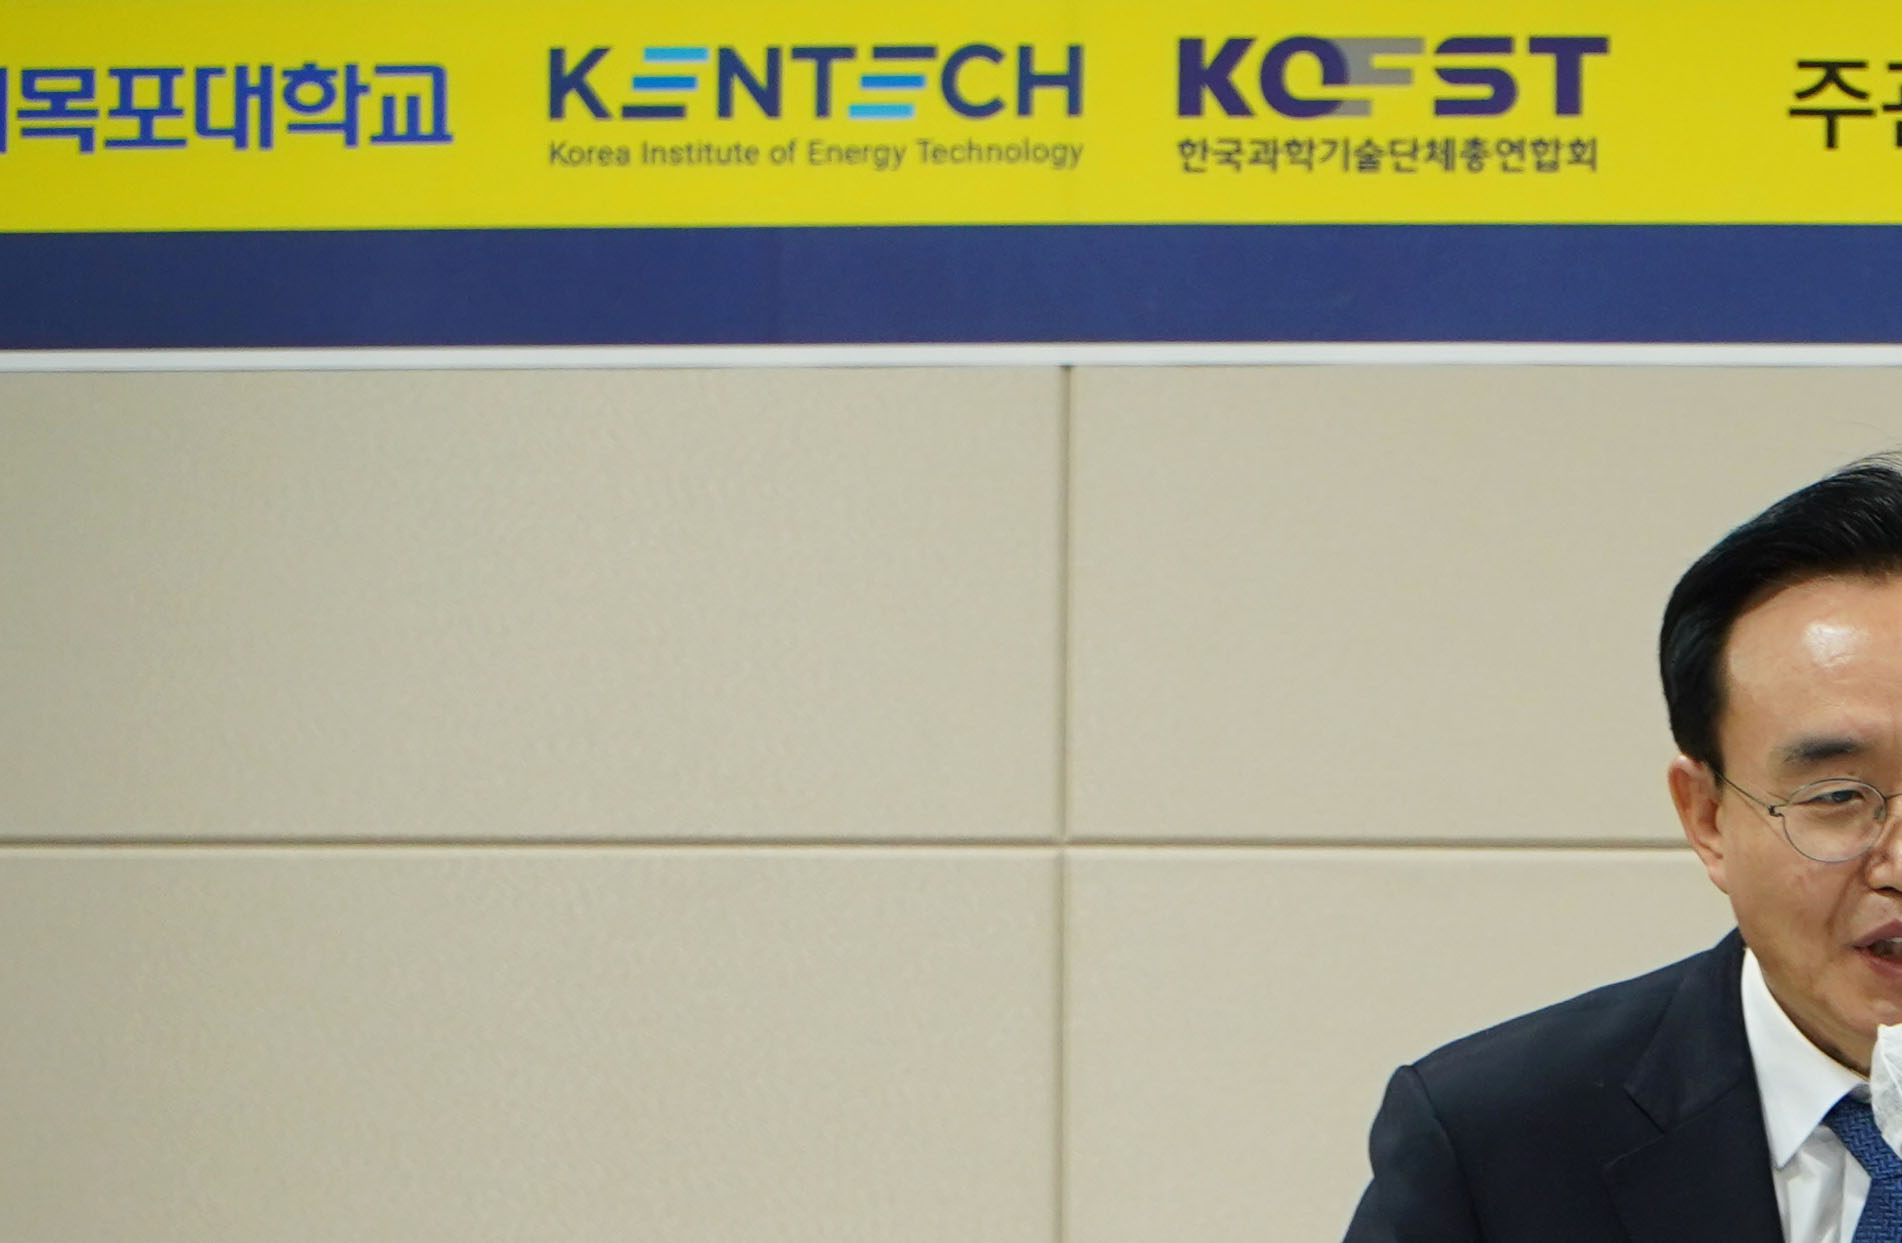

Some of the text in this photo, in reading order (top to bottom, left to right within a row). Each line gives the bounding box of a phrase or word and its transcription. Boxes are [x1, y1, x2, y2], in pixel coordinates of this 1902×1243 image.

[548, 43, 1084, 120] KENTECH
[1177, 35, 1610, 120] KOFST
[548, 138, 1085, 172] Korea Institute of Energy Technology
[1178, 136, 1598, 174] 한국과학기술단체총연합회
